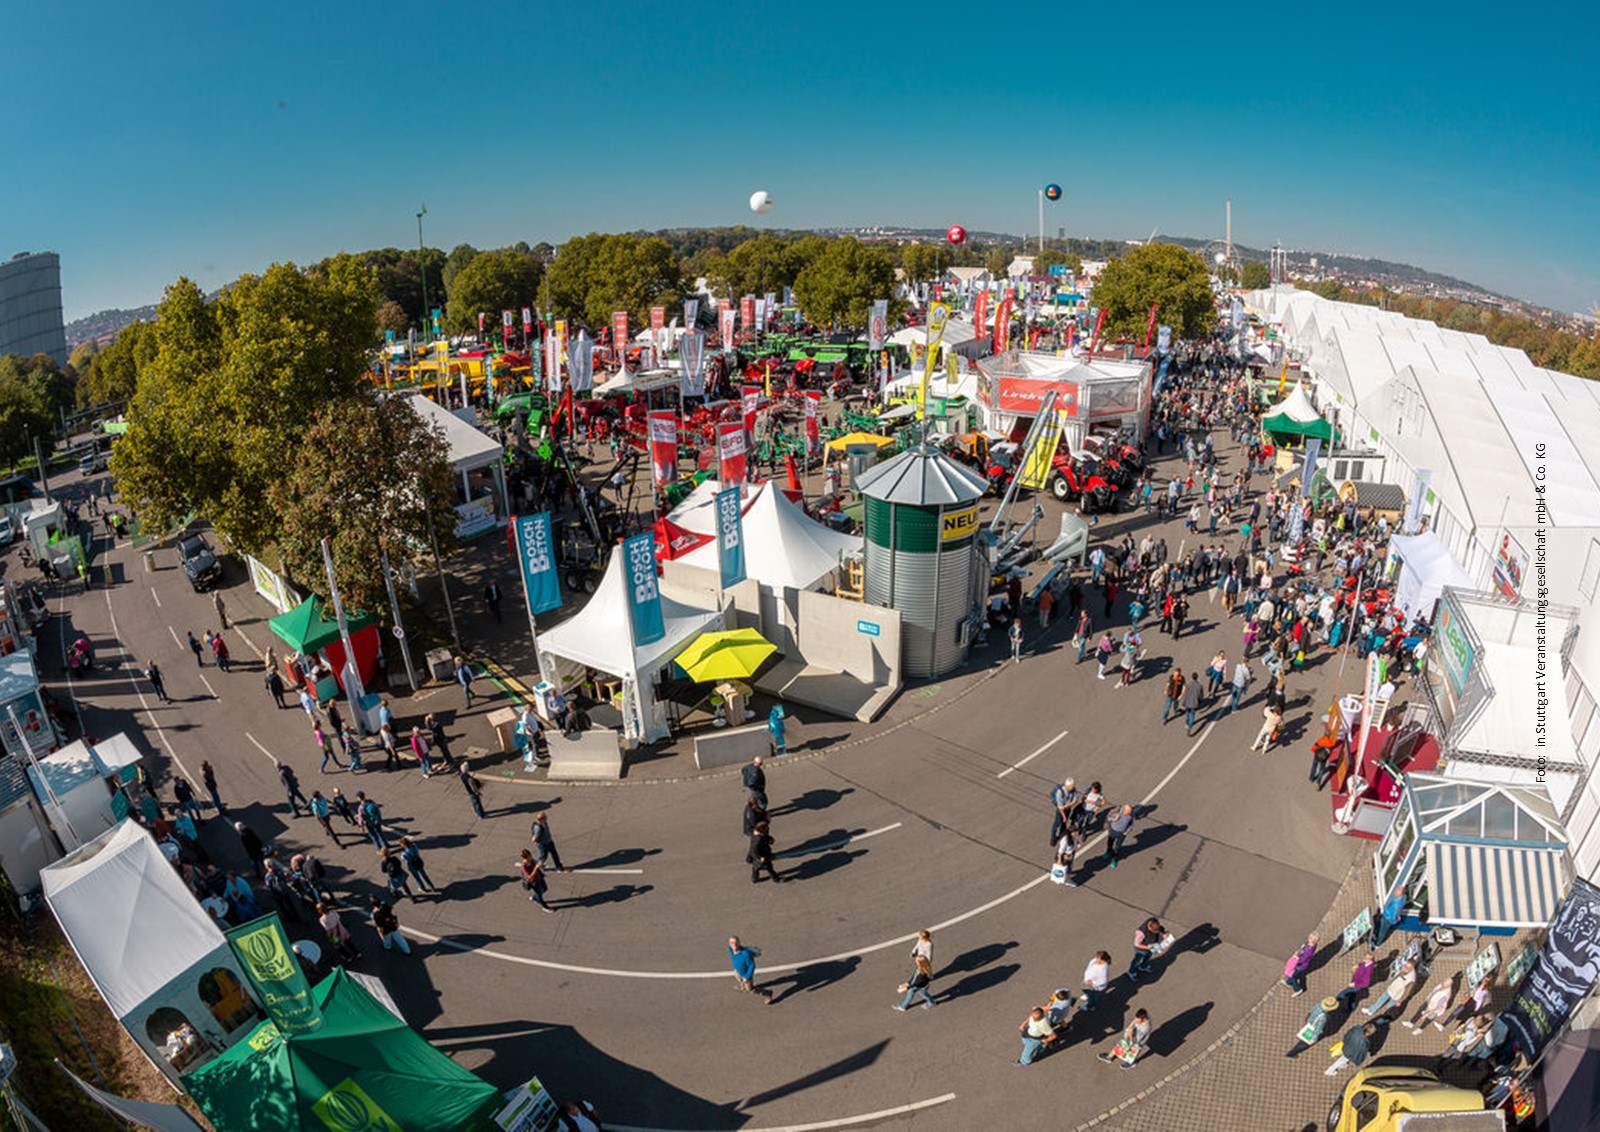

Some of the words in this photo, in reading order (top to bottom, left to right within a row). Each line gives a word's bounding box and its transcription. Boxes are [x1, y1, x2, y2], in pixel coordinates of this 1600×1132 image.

[534, 519, 550, 572] BETON
[721, 496, 734, 550] BOSCH
[729, 493, 739, 547] BETON
[944, 511, 976, 530] NEU
[523, 521, 539, 575] BOSCH
[629, 541, 646, 604] BOSCH
[639, 538, 658, 600] BETON
